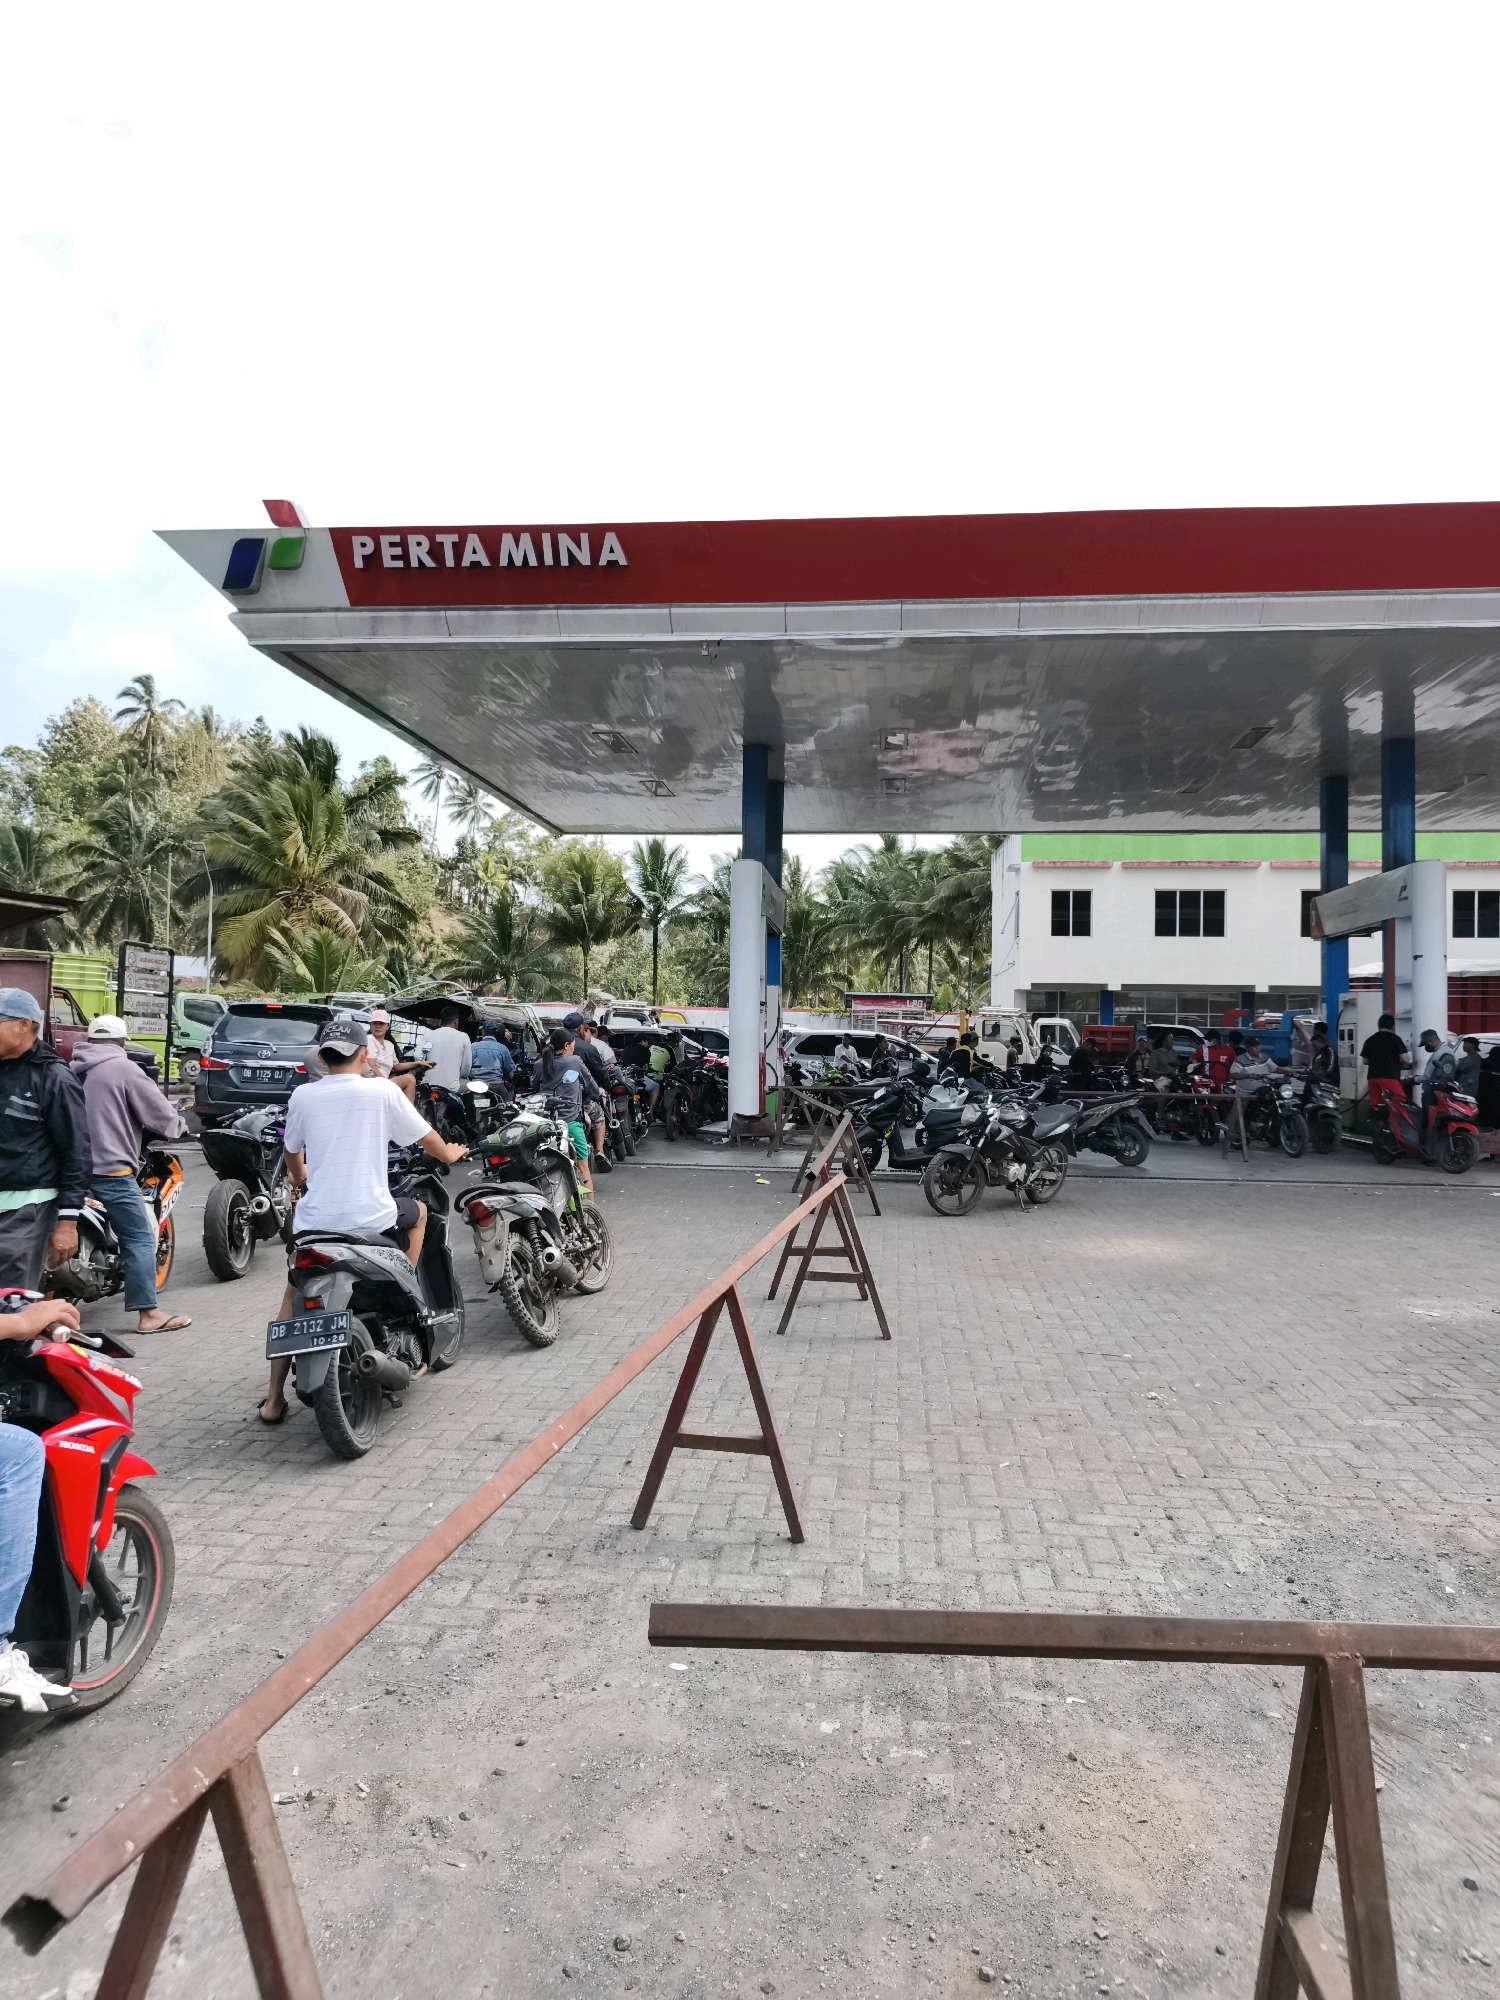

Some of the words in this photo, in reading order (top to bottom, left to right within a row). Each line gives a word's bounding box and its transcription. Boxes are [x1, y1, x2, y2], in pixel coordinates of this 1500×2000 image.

[351, 531, 628, 568] PERTAMINA
[906, 1000, 923, 1008] LPG
[243, 1069, 252, 1077] DB
[256, 1069, 271, 1078] 1125
[271, 1325, 286, 1339] DB
[293, 1319, 323, 1335] 2132
[330, 1315, 347, 1330] JM
[58, 1440, 96, 1454] HONDA
